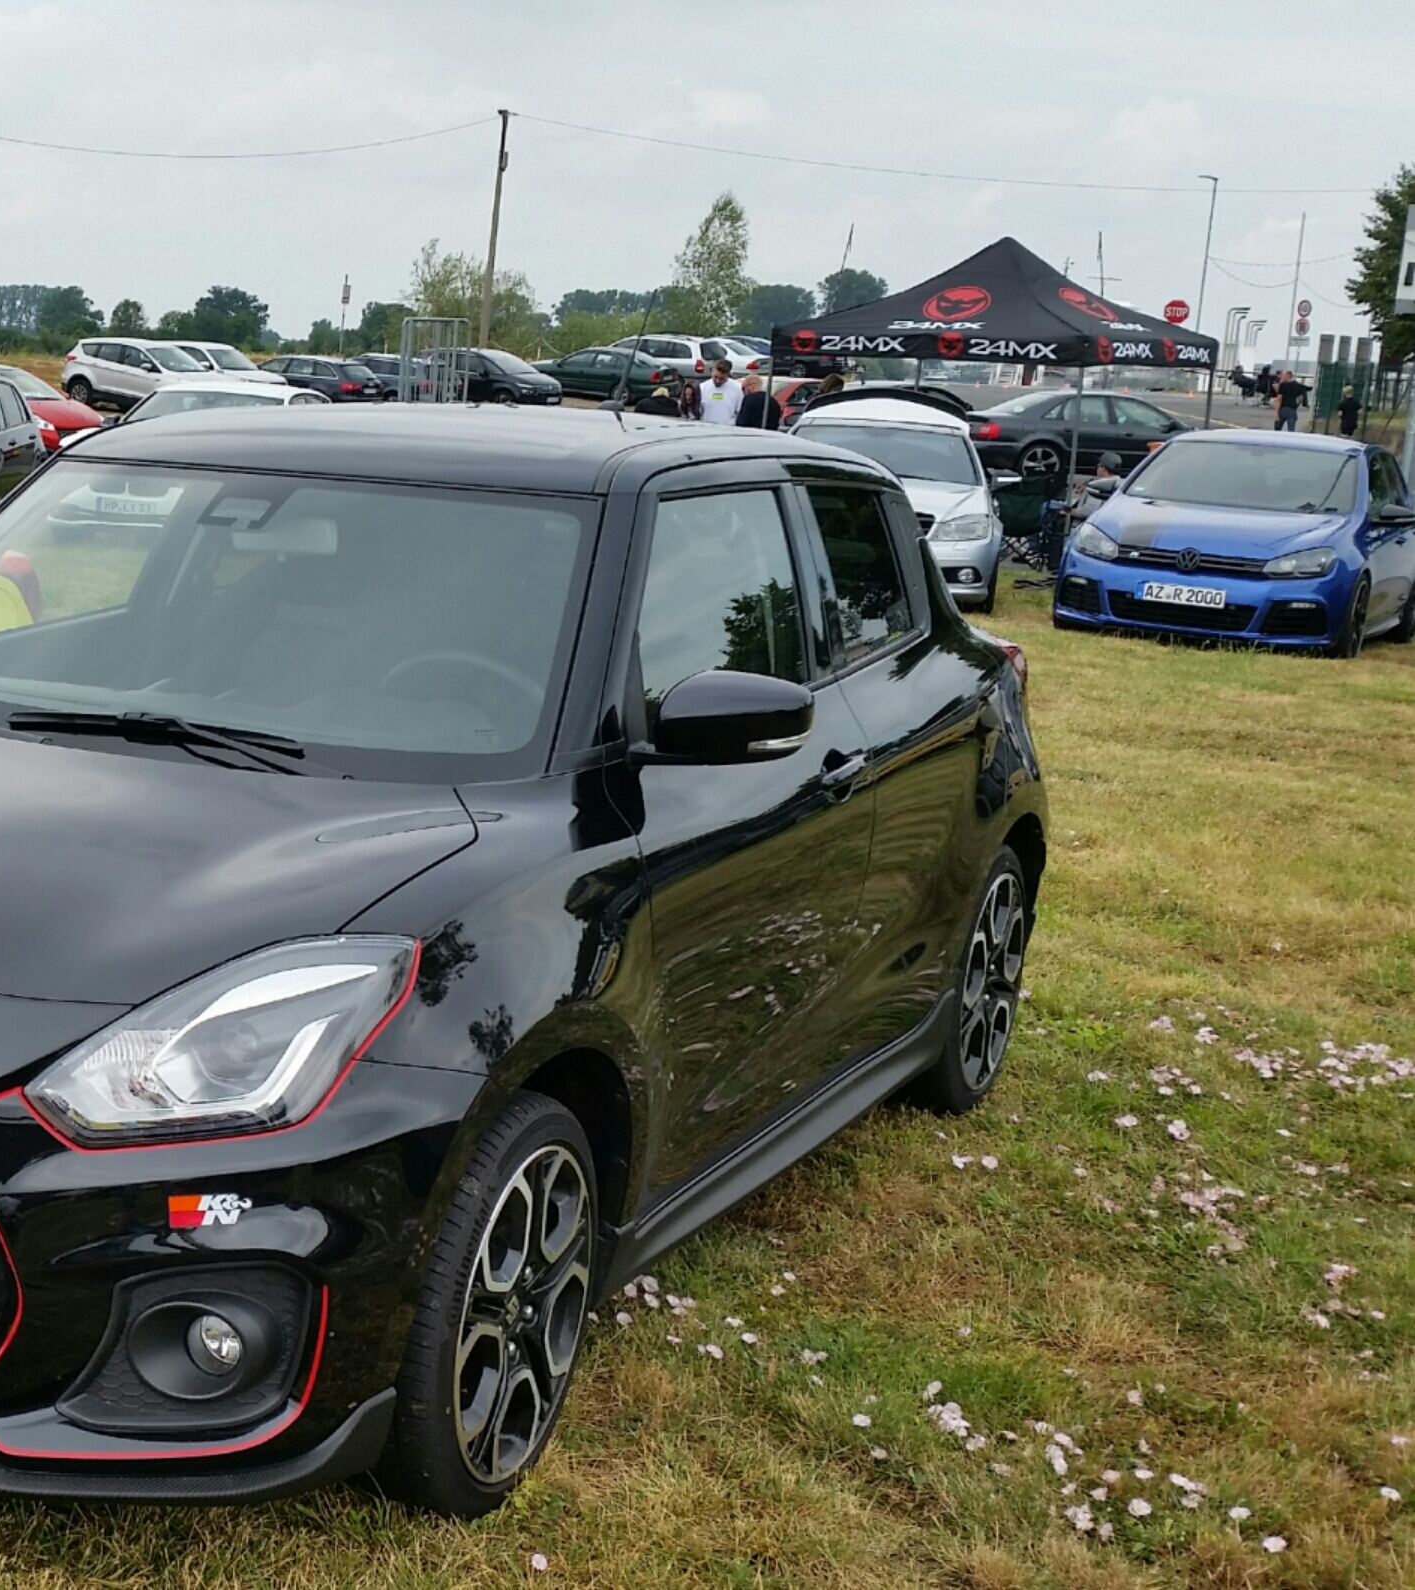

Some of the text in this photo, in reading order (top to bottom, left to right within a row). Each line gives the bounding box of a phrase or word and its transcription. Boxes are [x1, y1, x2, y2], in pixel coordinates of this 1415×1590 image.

[1165, 306, 1188, 317] STOP
[820, 334, 906, 352] 24MX
[968, 338, 1059, 360] 24MX
[1112, 342, 1154, 358] 24MX
[1175, 344, 1211, 363] 24MX
[1144, 584, 1165, 599] AZ
[1186, 589, 1223, 605] 2000
[445, 1196, 492, 1328] Continental
